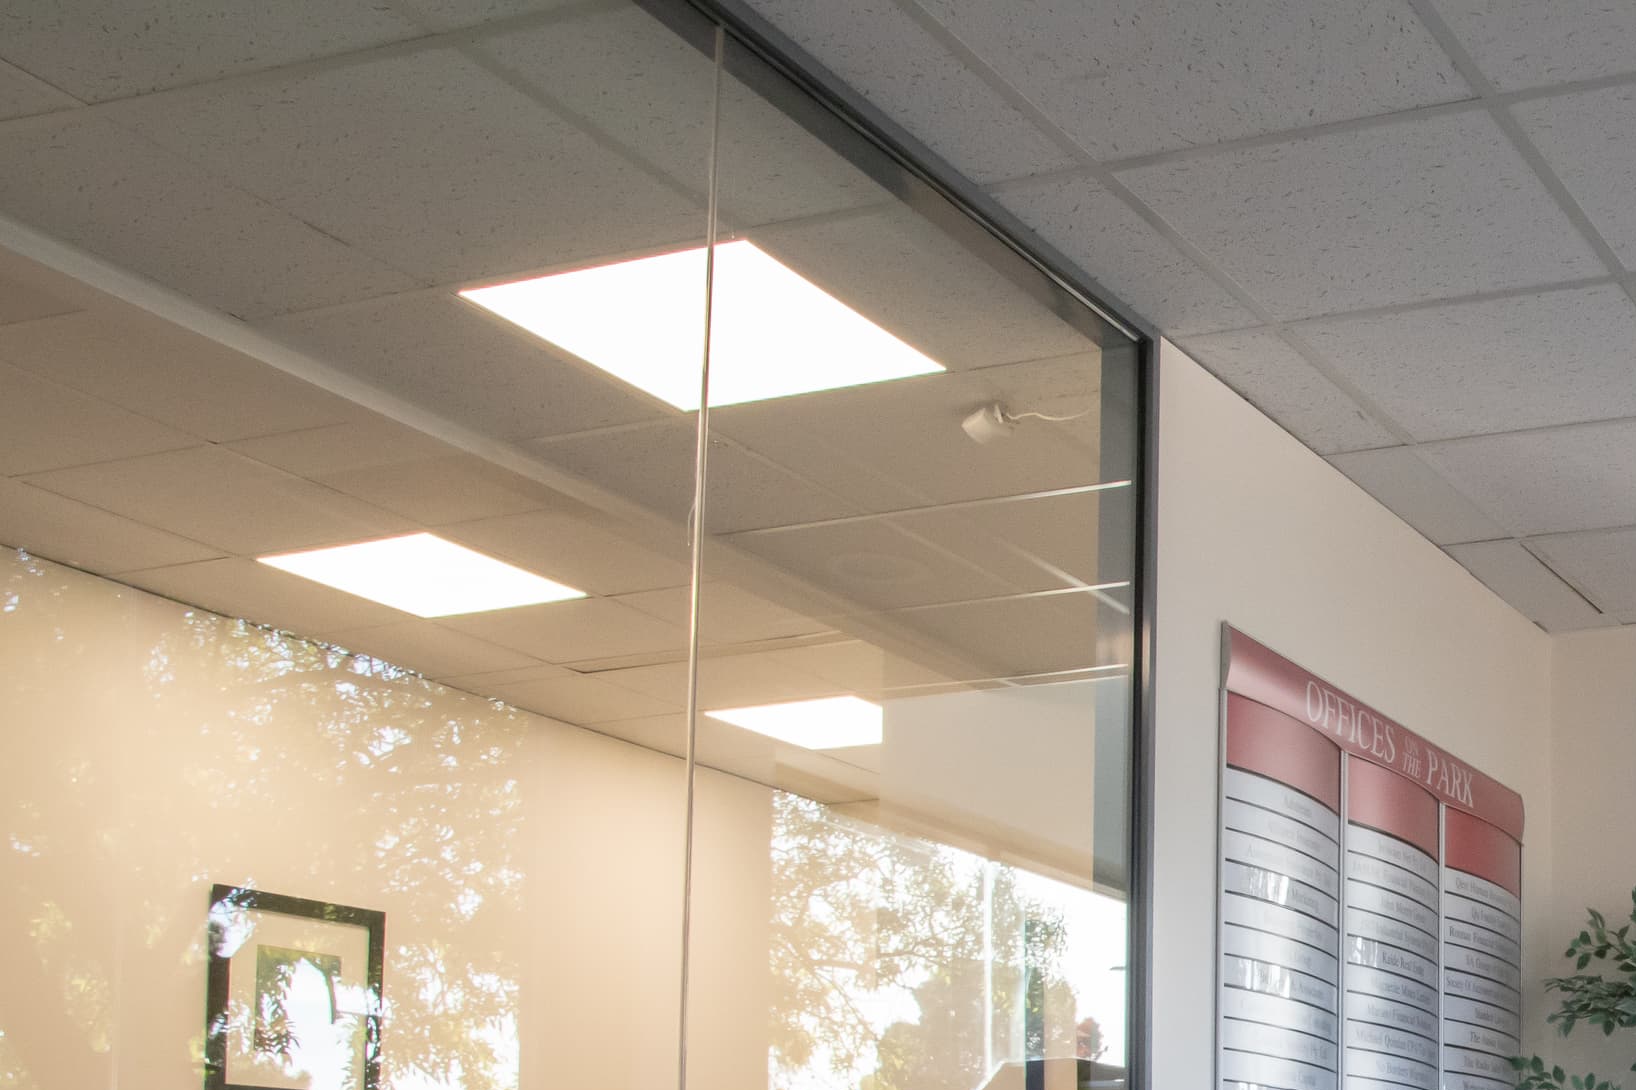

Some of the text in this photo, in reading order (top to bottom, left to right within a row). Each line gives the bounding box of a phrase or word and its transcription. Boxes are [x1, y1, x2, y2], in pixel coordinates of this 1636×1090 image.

[1306, 681, 1396, 764] OFFICES
[1402, 753, 1421, 779] THE
[1425, 747, 1474, 808] PARK
